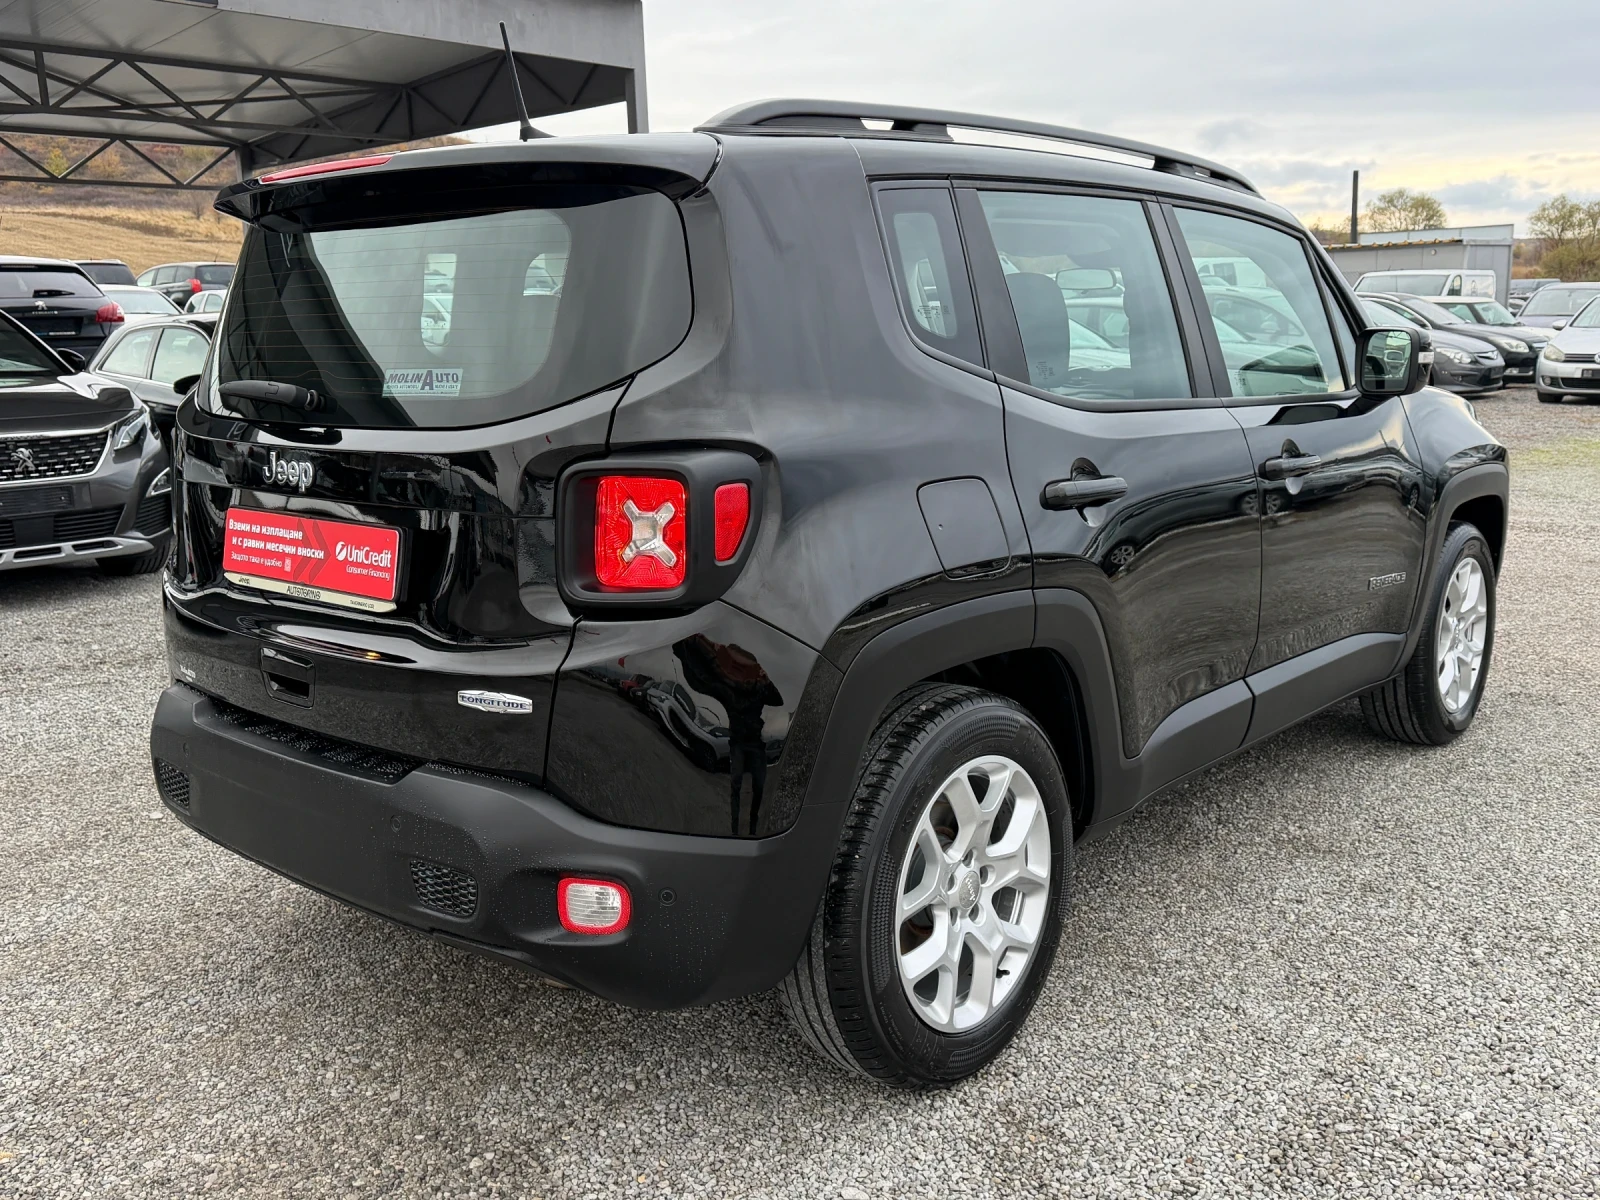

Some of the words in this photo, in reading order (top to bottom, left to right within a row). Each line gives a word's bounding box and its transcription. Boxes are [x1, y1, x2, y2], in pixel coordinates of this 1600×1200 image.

[386, 370, 459, 390] MOLINAUTO
[262, 451, 314, 493] Jeep
[229, 518, 251, 532] Вземи
[251, 524, 261, 534] на
[261, 526, 303, 540] изплащане
[232, 536, 237, 545] и
[238, 538, 242, 546] с
[243, 538, 265, 549] равни
[266, 542, 296, 555] месечни
[297, 547, 325, 559] вноски
[347, 544, 392, 568] UniCredit
[346, 564, 368, 576] Consumer
[368, 568, 390, 581] Financing
[461, 695, 527, 709] LONGITUDE
